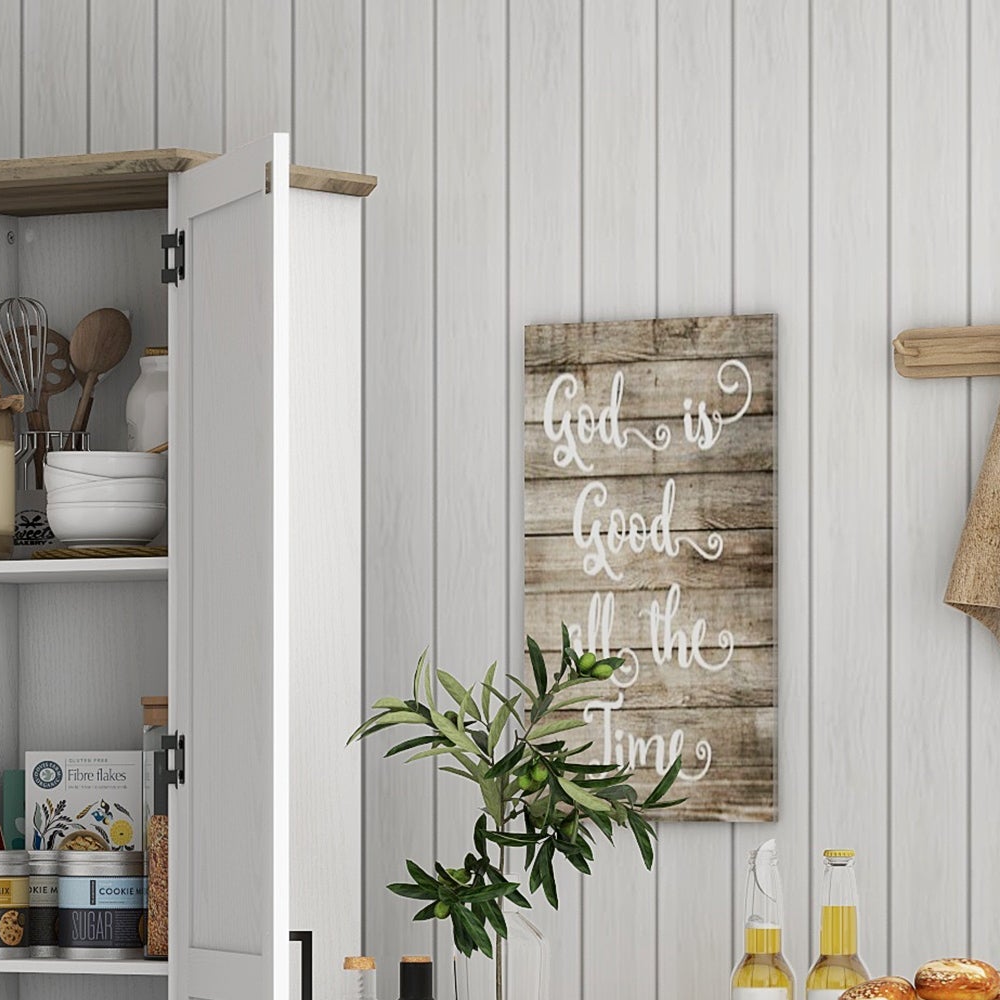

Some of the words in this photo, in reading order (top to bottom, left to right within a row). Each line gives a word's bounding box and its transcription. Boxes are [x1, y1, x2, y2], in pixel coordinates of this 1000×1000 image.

[543, 371, 671, 472] God
[684, 359, 752, 449] is
[14, 525, 55, 541] weets
[572, 478, 724, 581] Good
[638, 583, 734, 671] the
[583, 690, 712, 782] Time
[68, 768, 94, 782] Fibre
[96, 768, 126, 782] flakes
[98, 887, 134, 895] COOKIE
[72, 910, 113, 941] SUGAR
